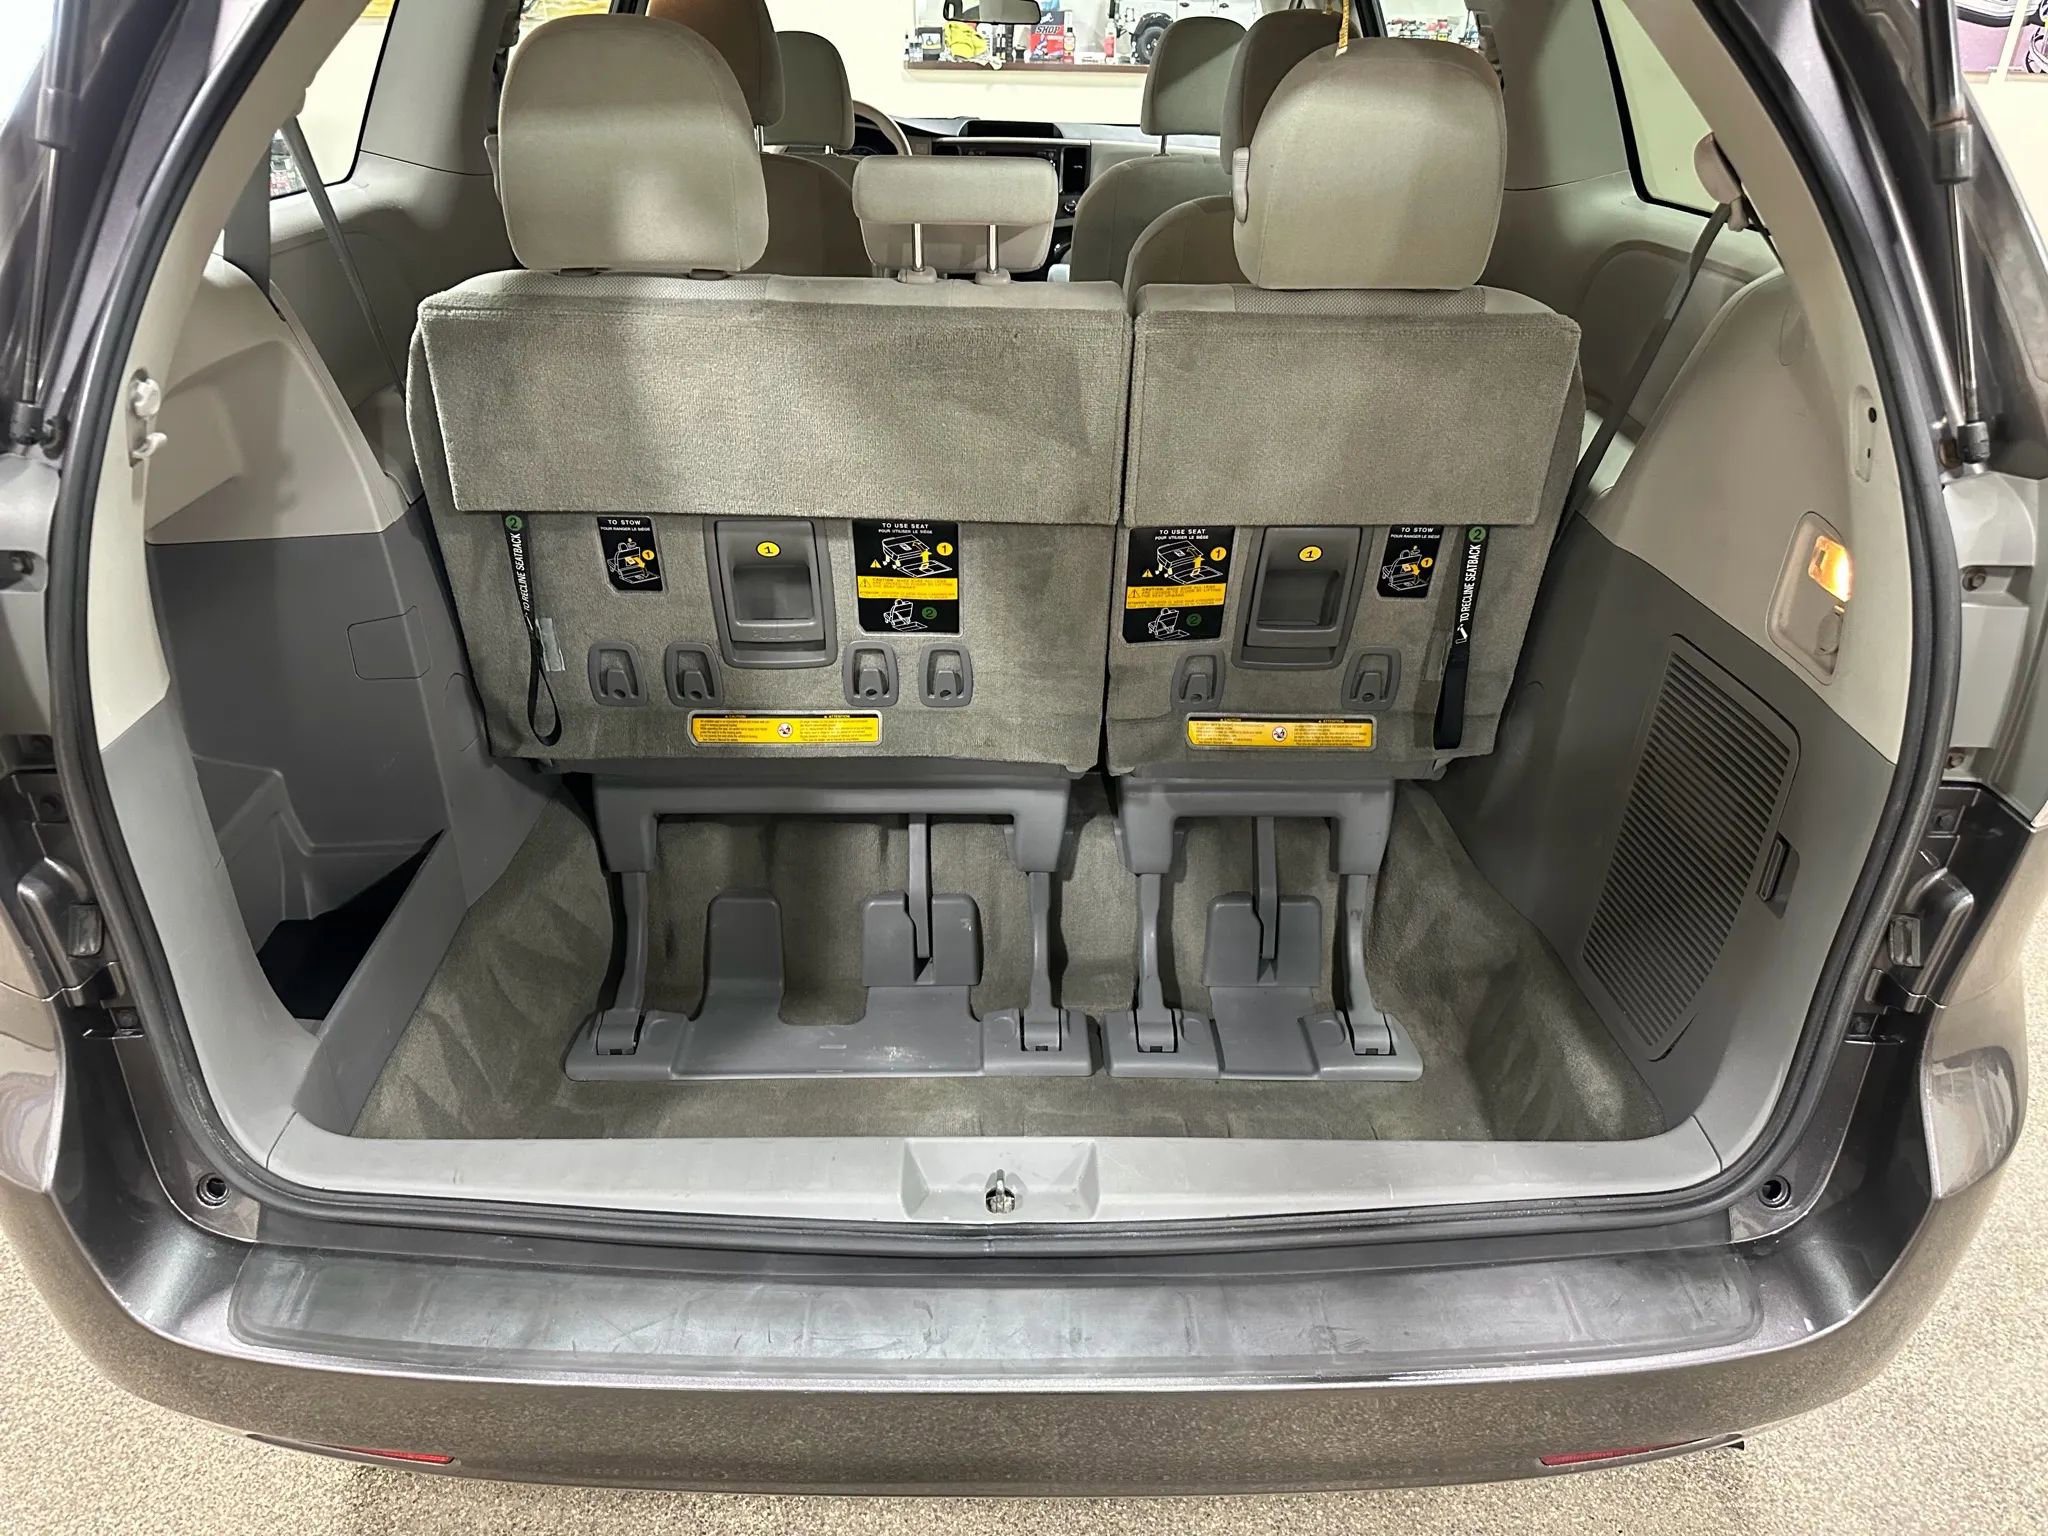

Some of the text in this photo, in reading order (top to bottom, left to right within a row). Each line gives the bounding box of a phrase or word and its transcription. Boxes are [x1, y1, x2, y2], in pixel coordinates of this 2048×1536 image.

[1035, 25, 1061, 34] SHOP
[509, 517, 518, 529] 2
[1473, 529, 1482, 540] 2
[762, 545, 774, 554] 1
[1303, 549, 1315, 558] 1
[510, 532, 530, 612] TO RECLINE SEATBACK
[1460, 544, 1482, 623] TO RECLINE SEATBACK
[925, 608, 934, 617] 2
[1190, 615, 1198, 625] 2
